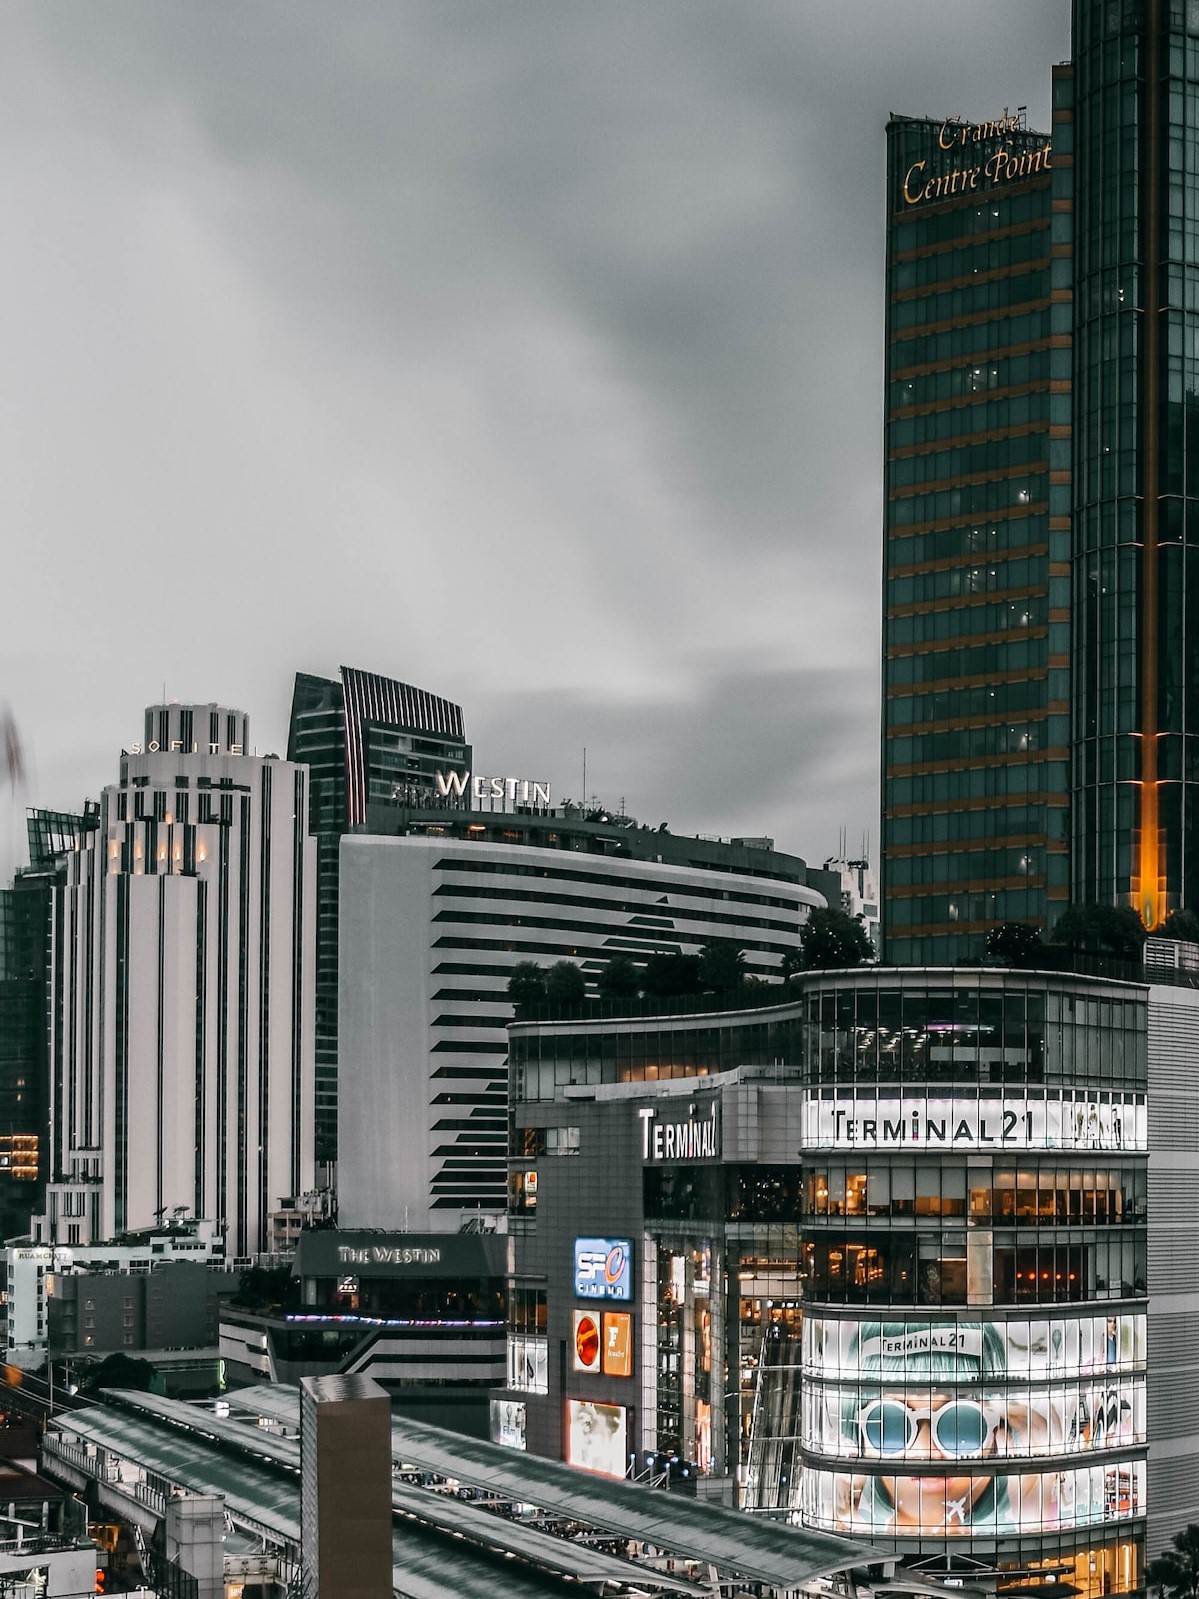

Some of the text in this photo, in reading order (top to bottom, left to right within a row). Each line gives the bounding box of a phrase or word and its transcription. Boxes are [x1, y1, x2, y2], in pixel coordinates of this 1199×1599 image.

[903, 140, 1052, 204] Centre Point
[131, 740, 265, 757] SOFITEL
[435, 769, 551, 804] WESTIN
[338, 1246, 441, 1264] THE WESTIN
[578, 1283, 624, 1297] CINEMA
